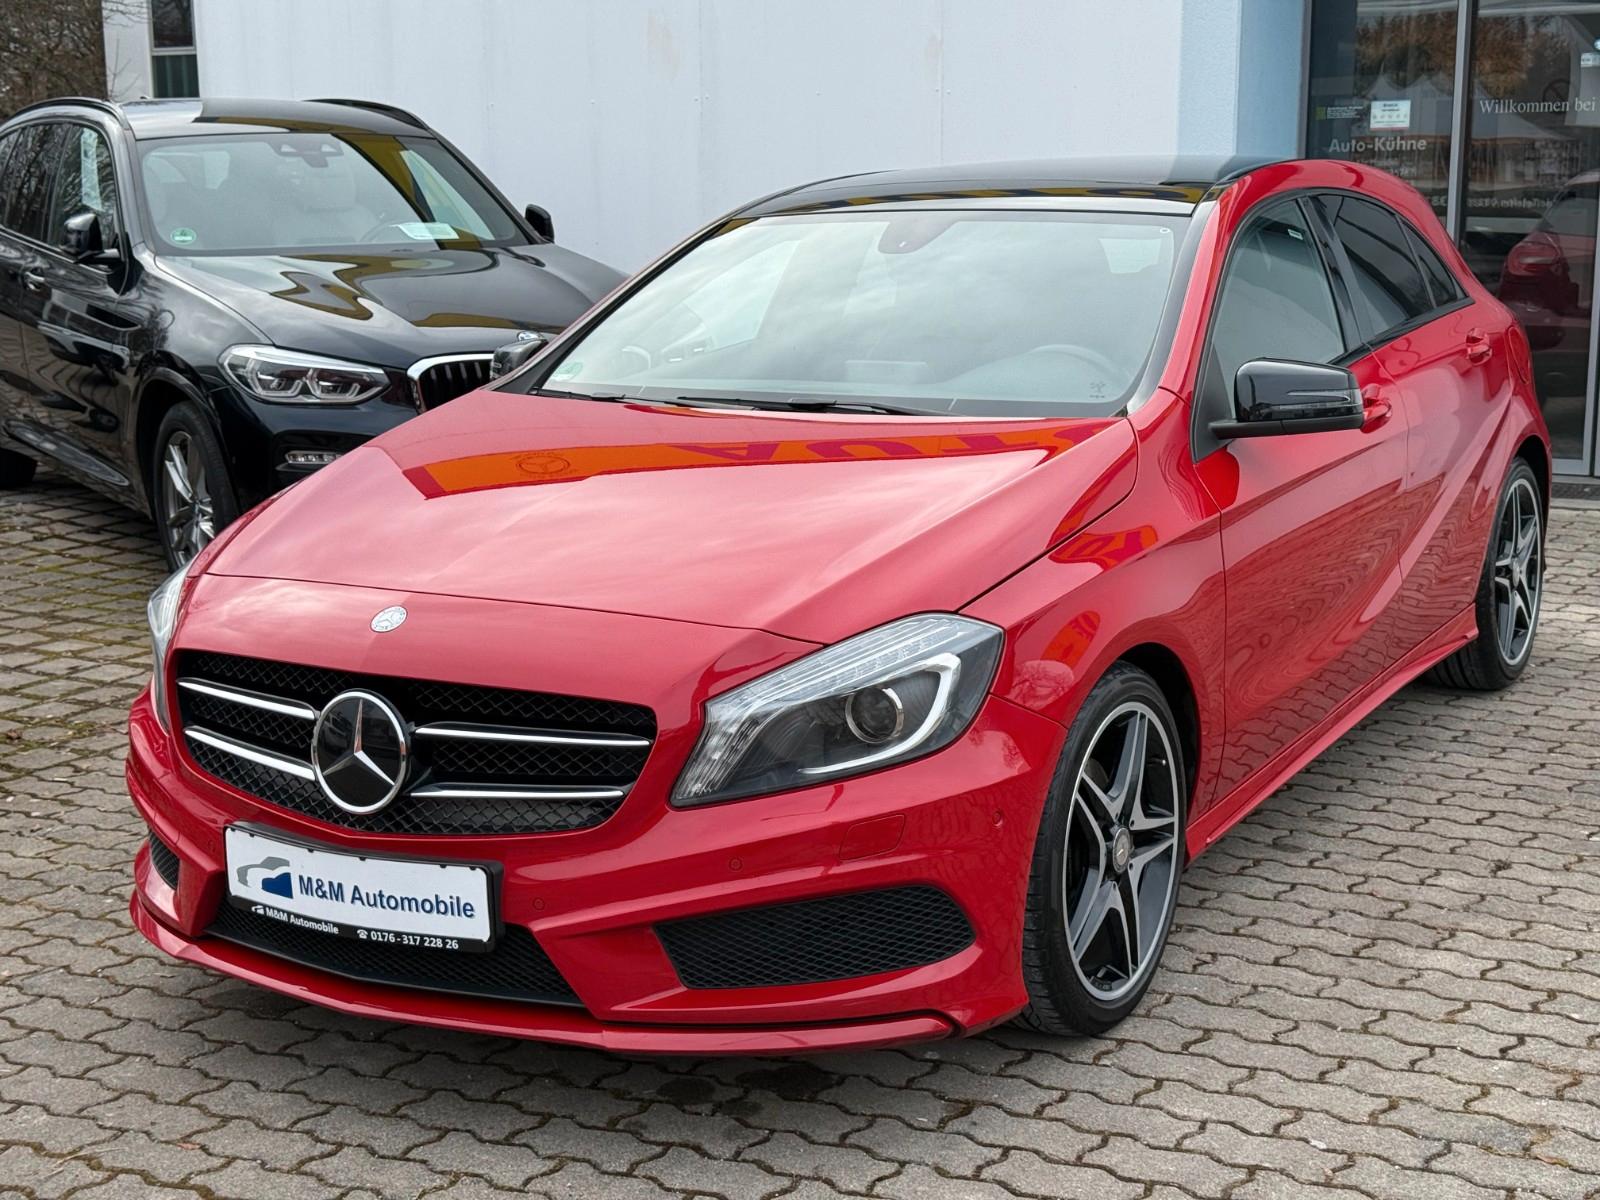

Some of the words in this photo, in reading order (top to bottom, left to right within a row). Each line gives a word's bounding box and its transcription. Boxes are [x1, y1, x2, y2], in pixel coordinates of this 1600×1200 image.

[1480, 98, 1569, 114] Willkommen
[1574, 97, 1596, 112] bei
[1328, 136, 1427, 153] Auto-Kühne
[298, 873, 345, 904] M&M
[350, 884, 476, 919] Automobile
[265, 906, 288, 922] M&M
[289, 914, 340, 935] Automobile
[423, 936, 443, 949] 228
[445, 938, 459, 950] 26
